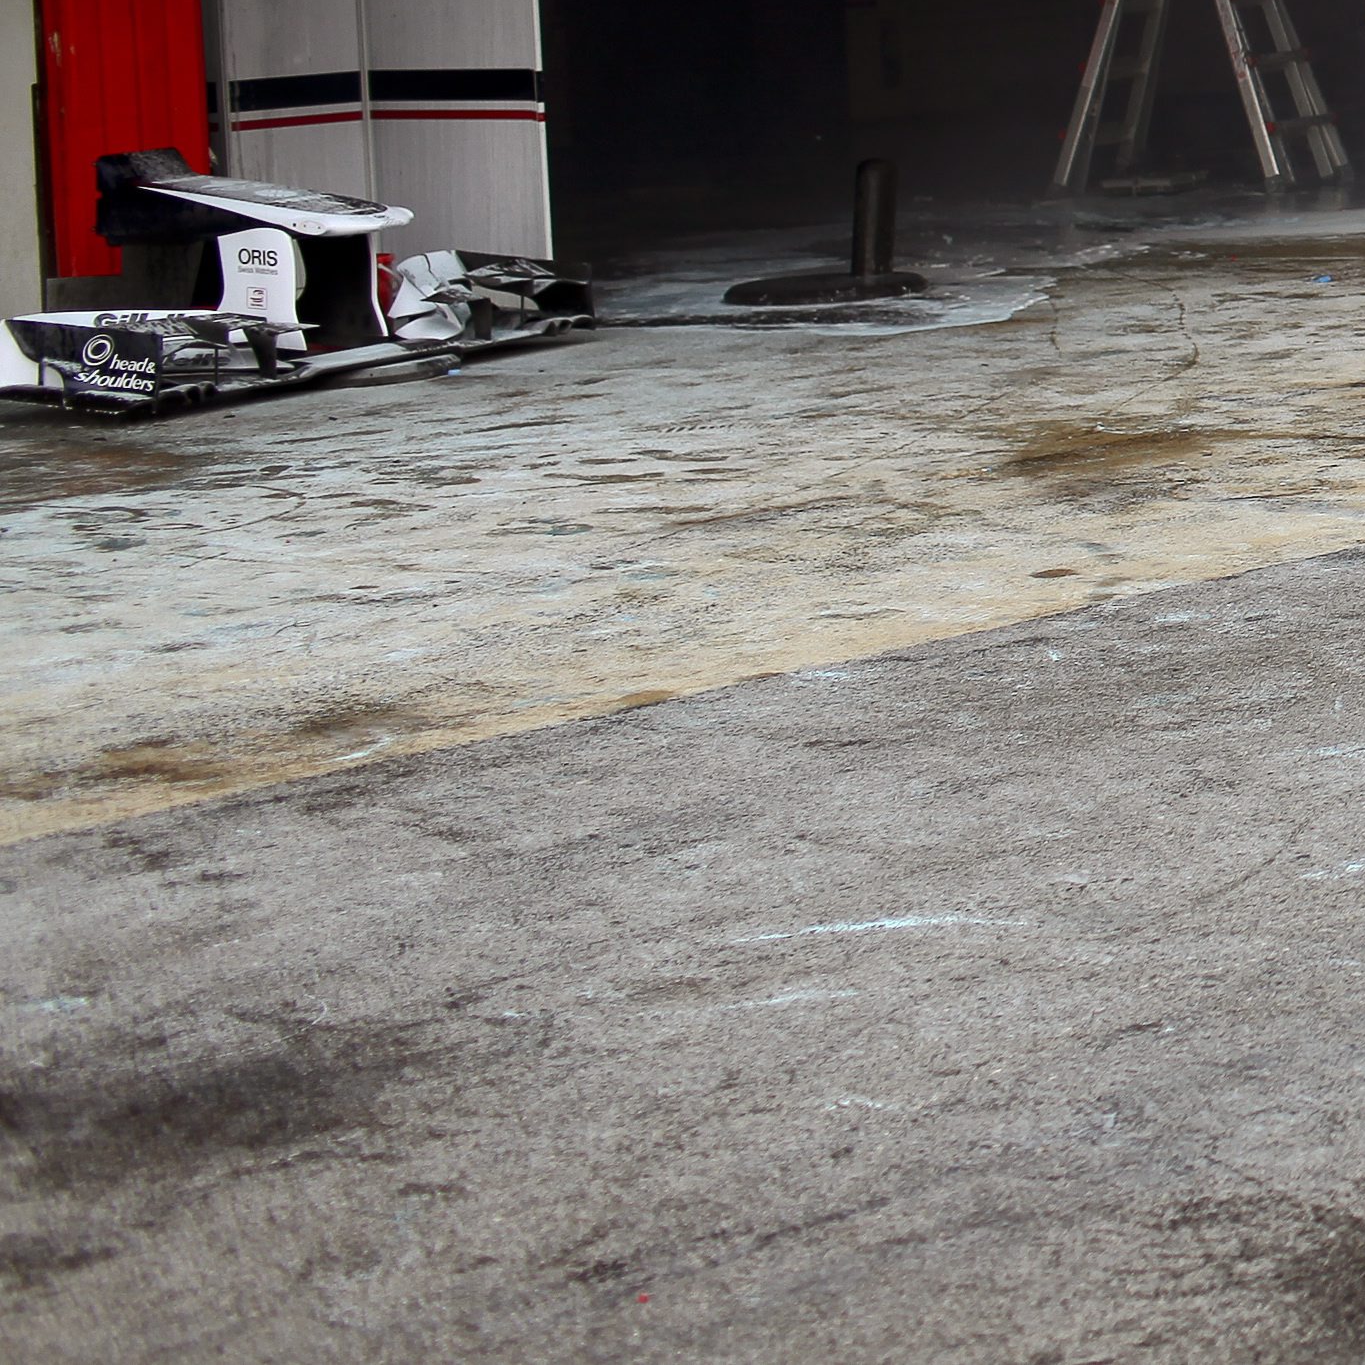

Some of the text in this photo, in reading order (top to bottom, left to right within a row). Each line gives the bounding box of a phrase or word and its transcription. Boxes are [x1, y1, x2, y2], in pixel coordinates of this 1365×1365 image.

[238, 247, 278, 267] ORIS
[109, 353, 157, 374] head&
[75, 368, 156, 392] shoulders
